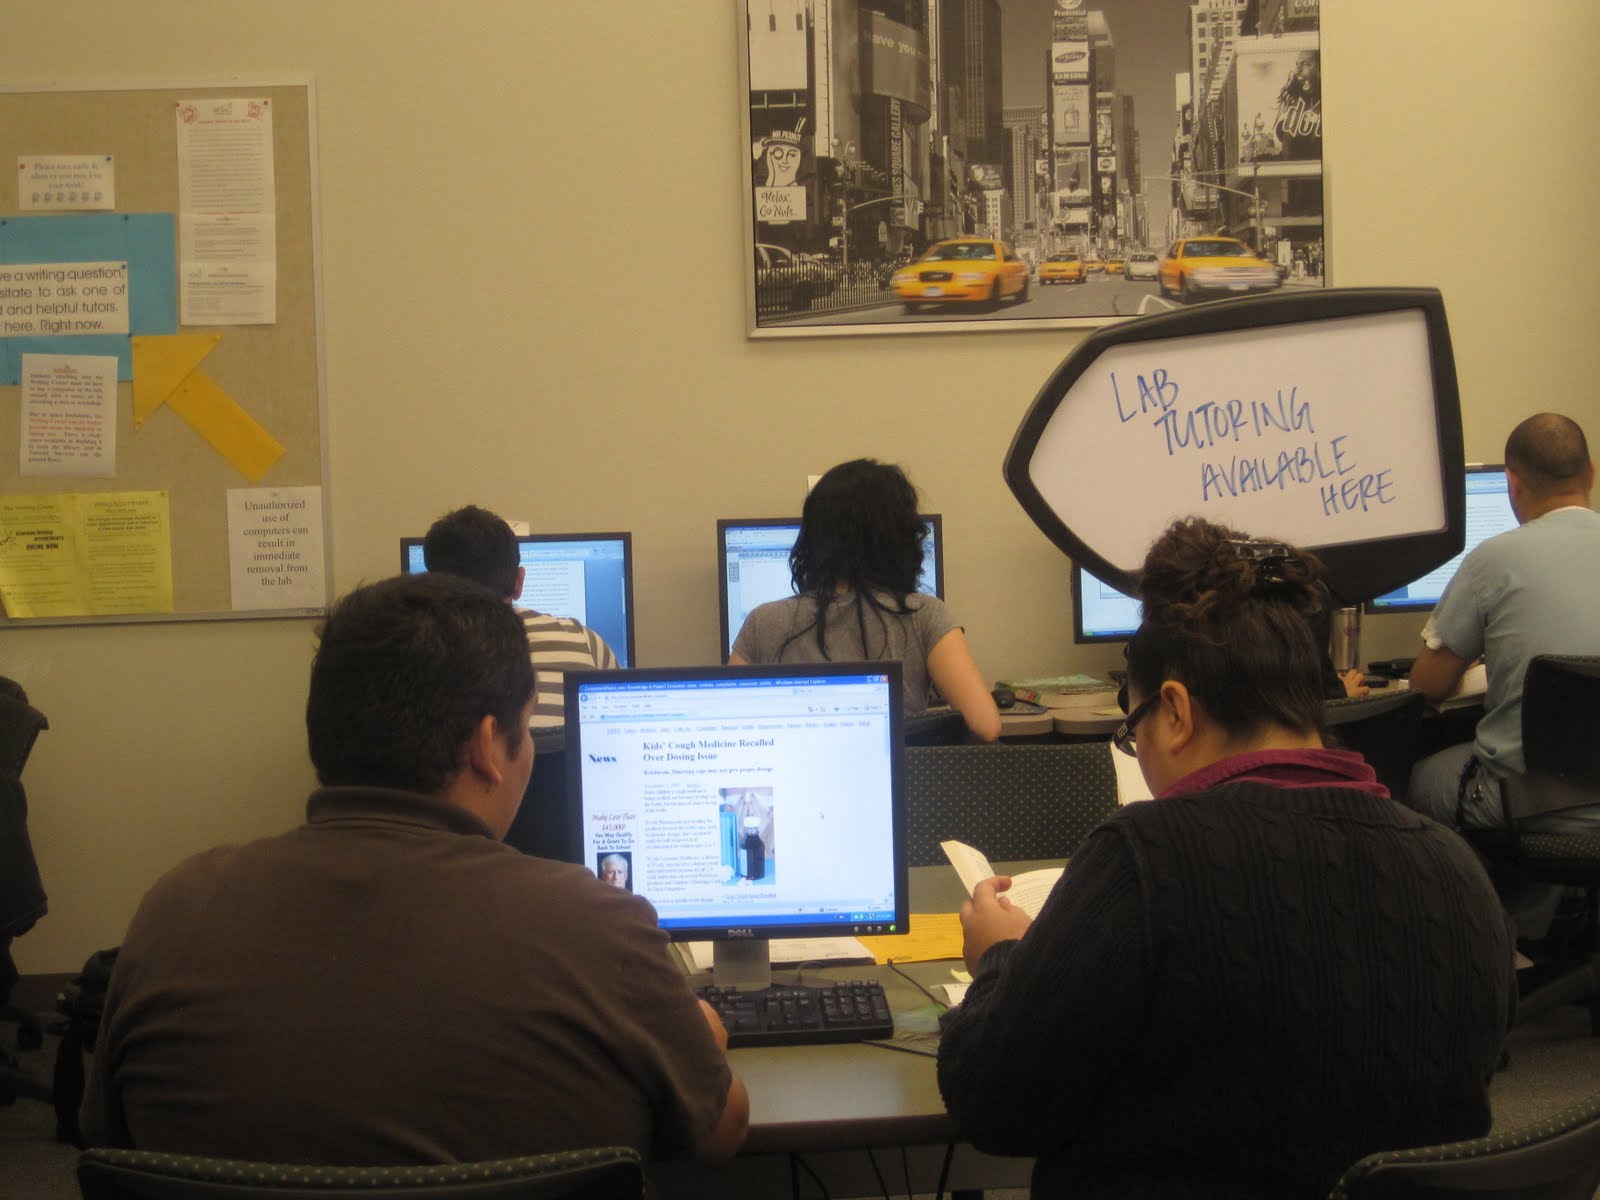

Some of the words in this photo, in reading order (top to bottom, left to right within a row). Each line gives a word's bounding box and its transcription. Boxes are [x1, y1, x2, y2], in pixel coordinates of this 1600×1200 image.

[898, 41, 916, 56] you
[782, 131, 802, 141] PEANUT
[892, 139, 902, 175] SQUARE
[15, 272, 23, 280] a
[26, 270, 65, 283] writing
[68, 268, 124, 281] question,
[0, 287, 32, 298] sitate
[39, 288, 50, 297] to
[56, 286, 76, 296] ask
[82, 287, 107, 296] one
[113, 284, 125, 295] of
[7, 304, 32, 315] and
[36, 303, 78, 315] helpful
[82, 301, 118, 312] tutors.
[4, 321, 36, 332] here.
[40, 320, 71, 333] Right
[76, 320, 104, 329] now.
[1110, 368, 1179, 422] LAB
[1154, 386, 1315, 455] TUTORING
[1201, 435, 1357, 501] AVAILABLE
[1320, 468, 1396, 516] HERE
[245, 500, 305, 510] Unauthorized
[280, 512, 289, 522] of
[243, 527, 290, 537] computers
[258, 539, 283, 548] result
[254, 552, 300, 561] immediate
[247, 564, 284, 574] removal
[286, 564, 308, 573] from
[262, 577, 275, 586] the
[278, 576, 294, 585] lab.
[668, 742, 696, 751] Cough
[698, 740, 737, 749] Medicine
[739, 739, 774, 747] Recalled
[589, 754, 616, 763] News
[643, 754, 664, 762] Over
[666, 753, 695, 762] Dosing
[728, 929, 754, 937] DELL
